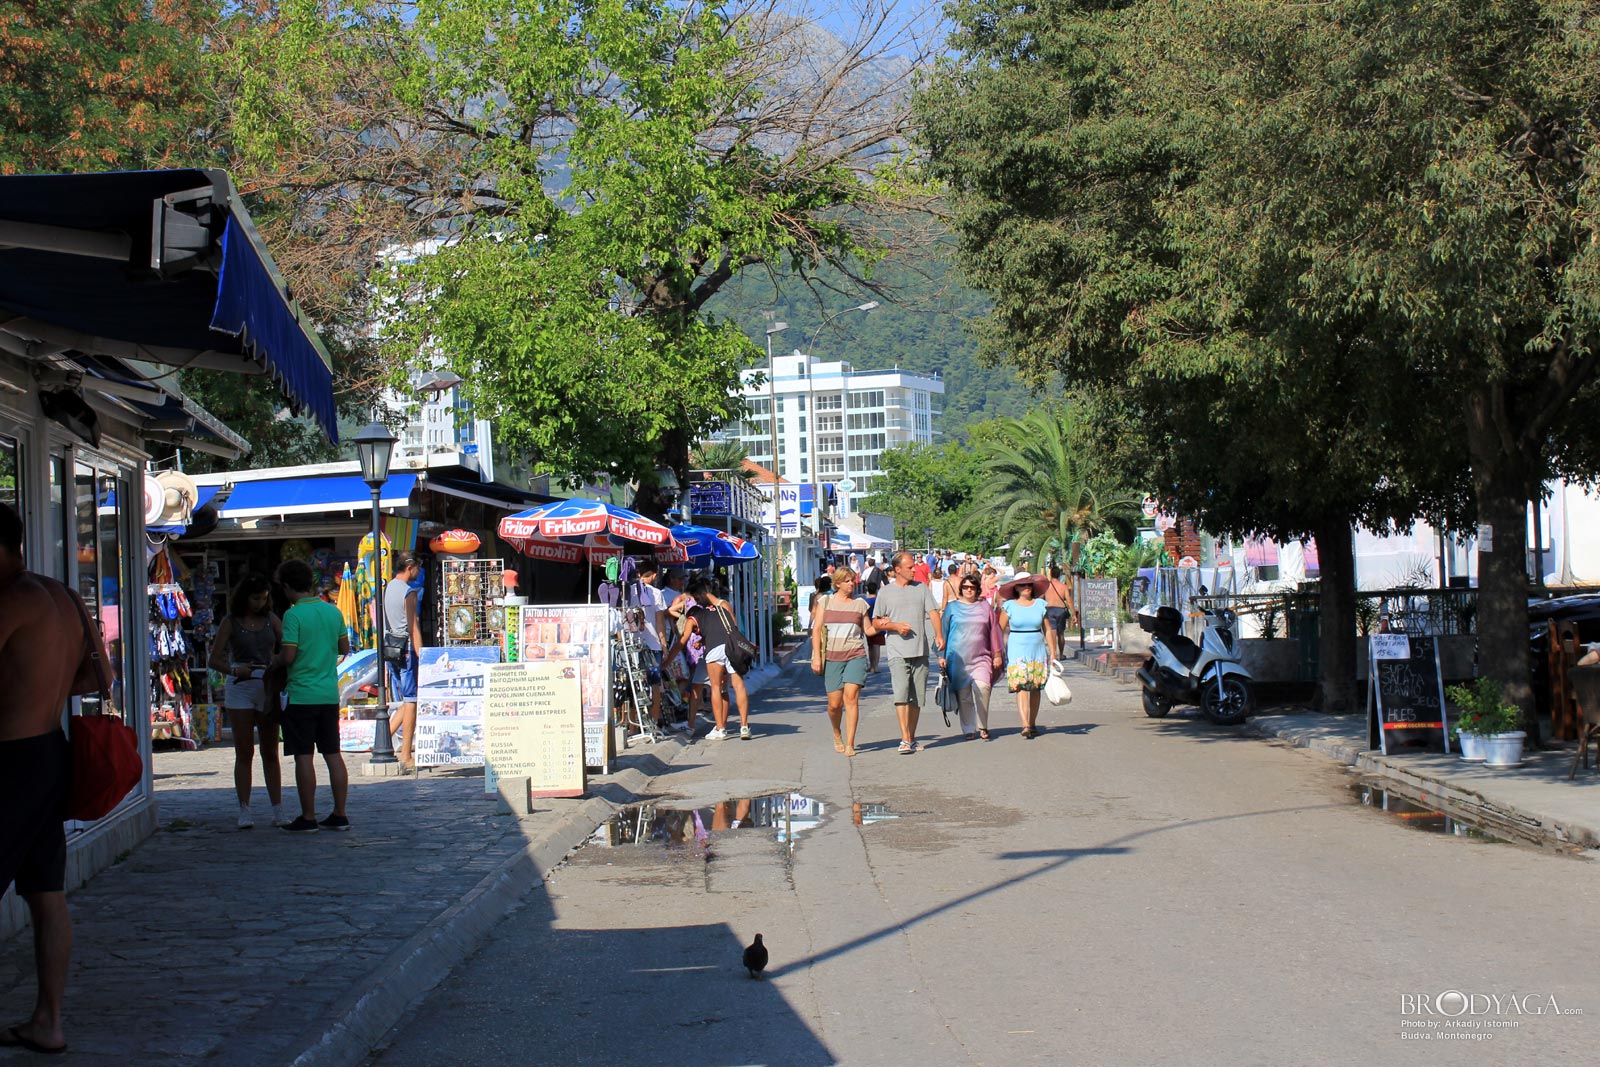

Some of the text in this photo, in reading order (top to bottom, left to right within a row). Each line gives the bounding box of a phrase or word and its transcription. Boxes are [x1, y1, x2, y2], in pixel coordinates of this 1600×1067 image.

[545, 519, 600, 534] Frikom
[611, 518, 663, 542] Frikom
[770, 525, 797, 535] Tme
[448, 678, 483, 687] CHART
[419, 725, 436, 735] TAXI
[418, 740, 438, 750] BOAT
[417, 753, 451, 764] FISHING
